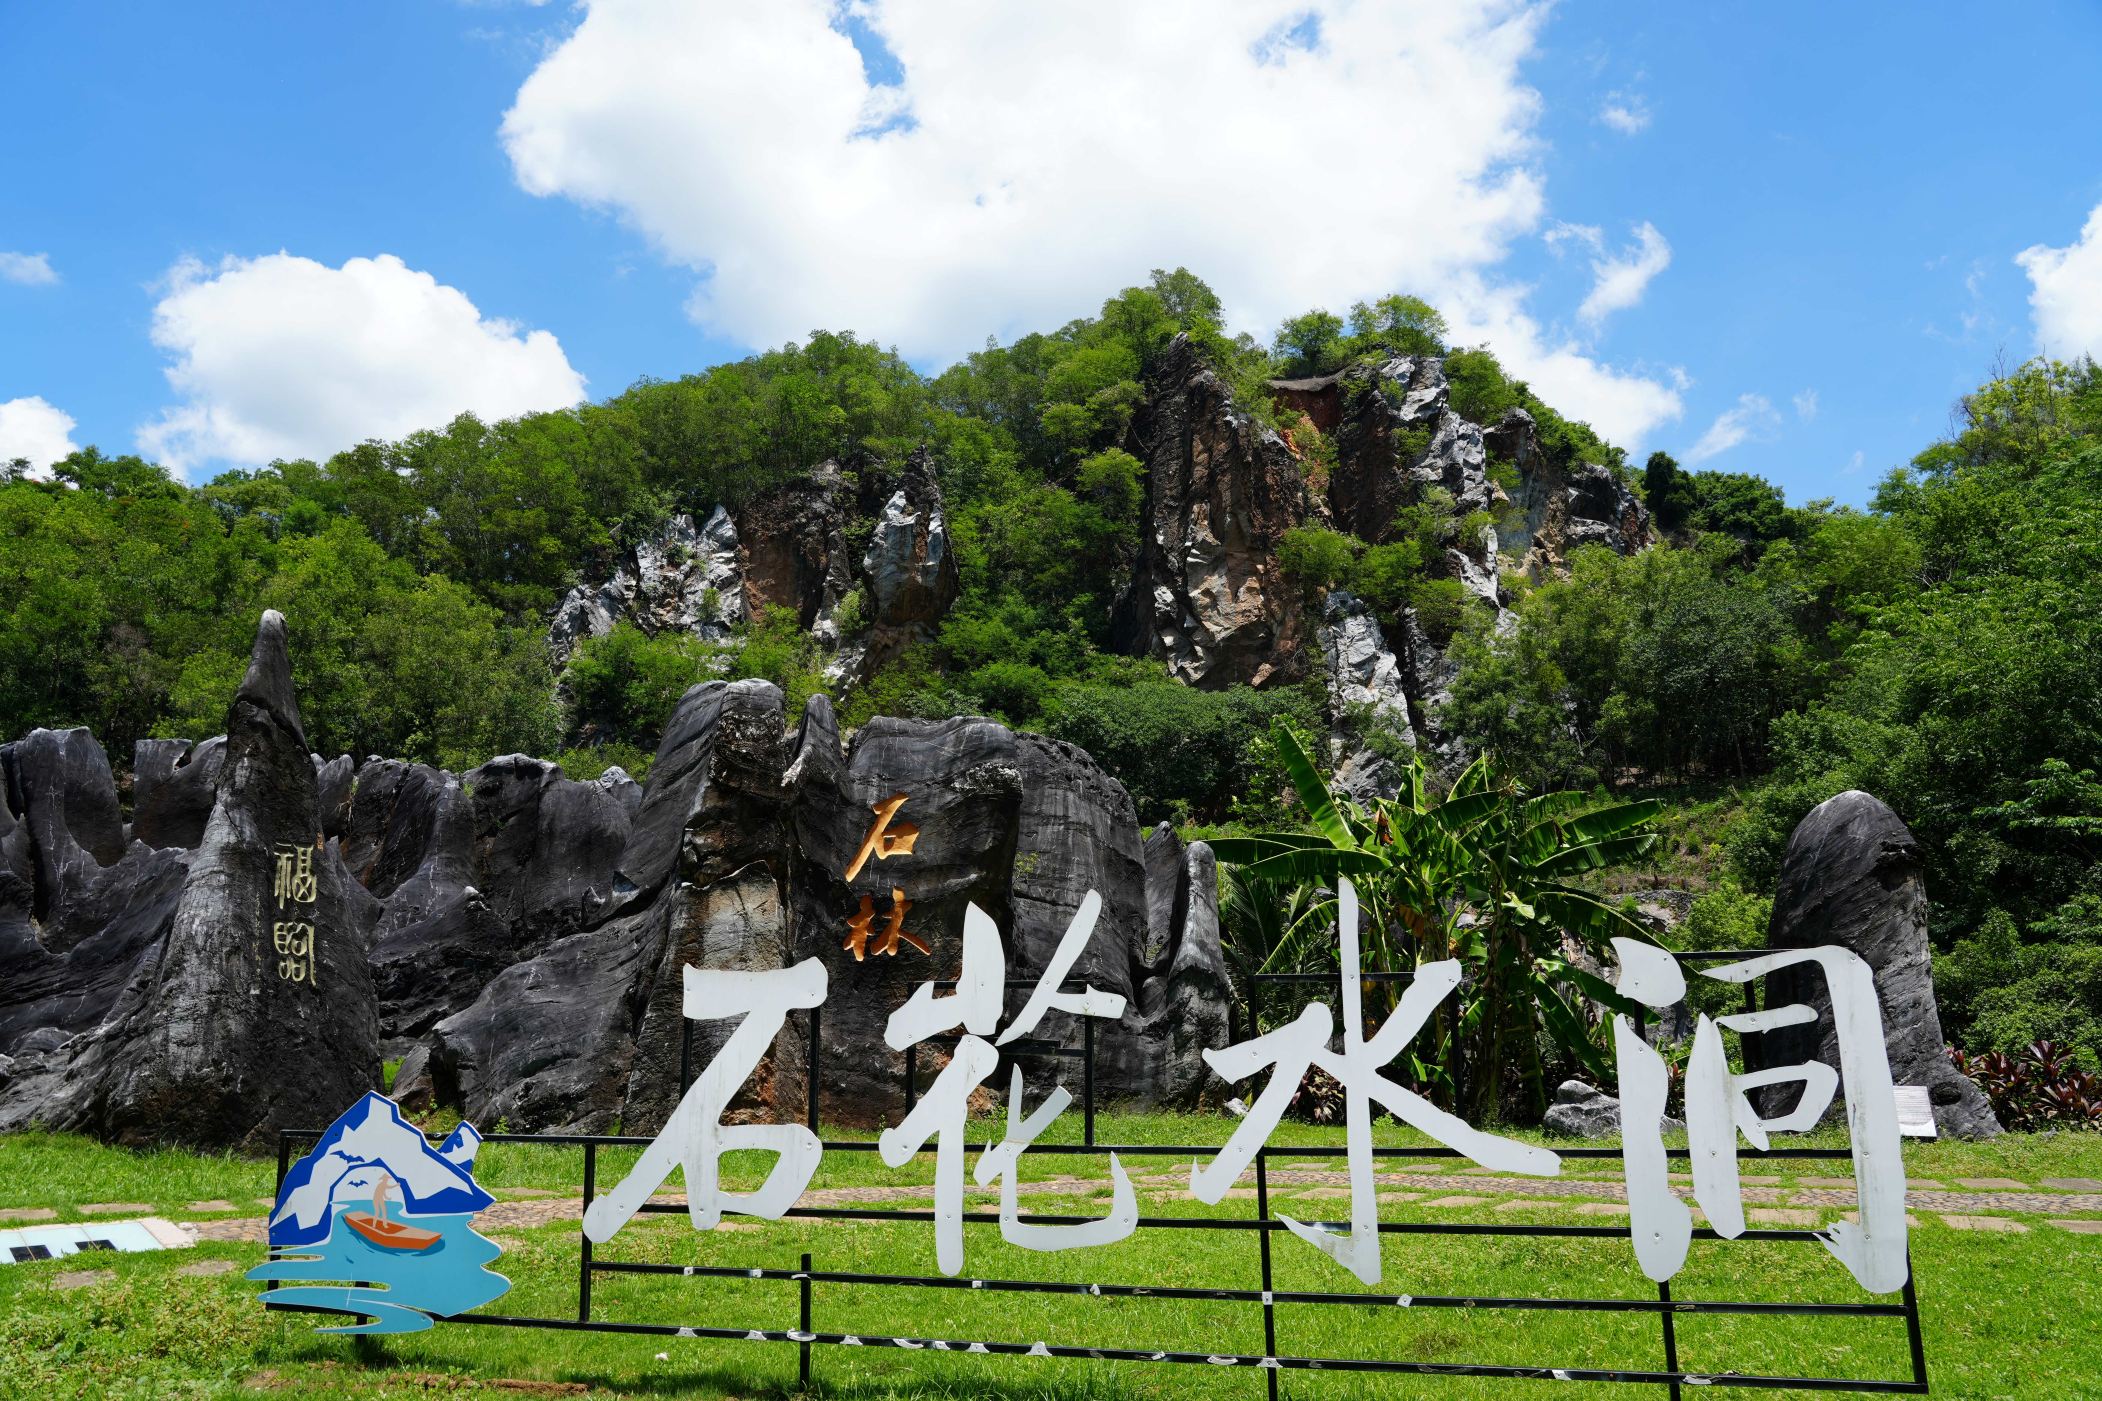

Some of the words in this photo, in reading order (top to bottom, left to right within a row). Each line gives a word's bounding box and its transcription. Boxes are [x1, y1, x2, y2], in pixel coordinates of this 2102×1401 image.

[843, 791, 932, 961] 石林
[583, 877, 1907, 1293] 石花水洞
